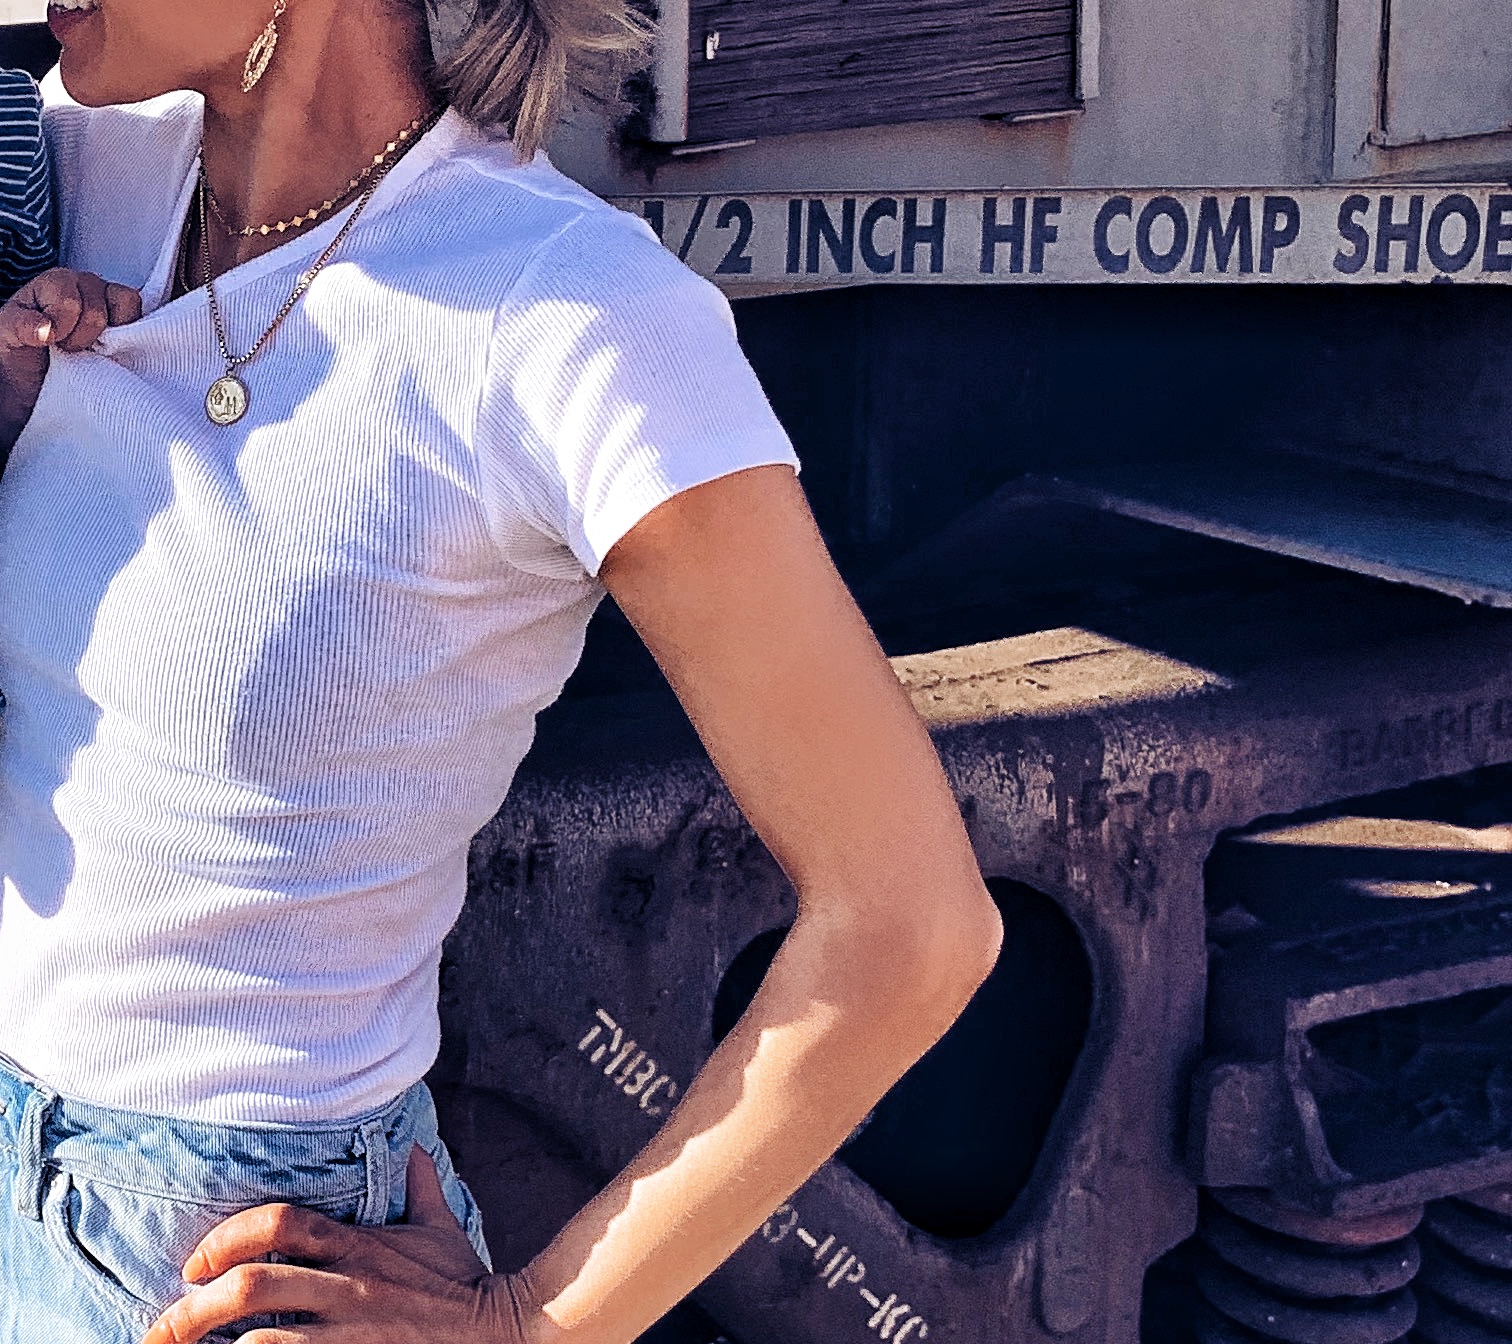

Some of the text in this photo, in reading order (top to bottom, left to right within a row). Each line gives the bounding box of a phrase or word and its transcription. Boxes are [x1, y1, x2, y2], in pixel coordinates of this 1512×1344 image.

[785, 197, 948, 274] INCH
[980, 196, 1063, 274] HF
[1093, 194, 1301, 274] COMP
[1333, 194, 1512, 273] SHOE
